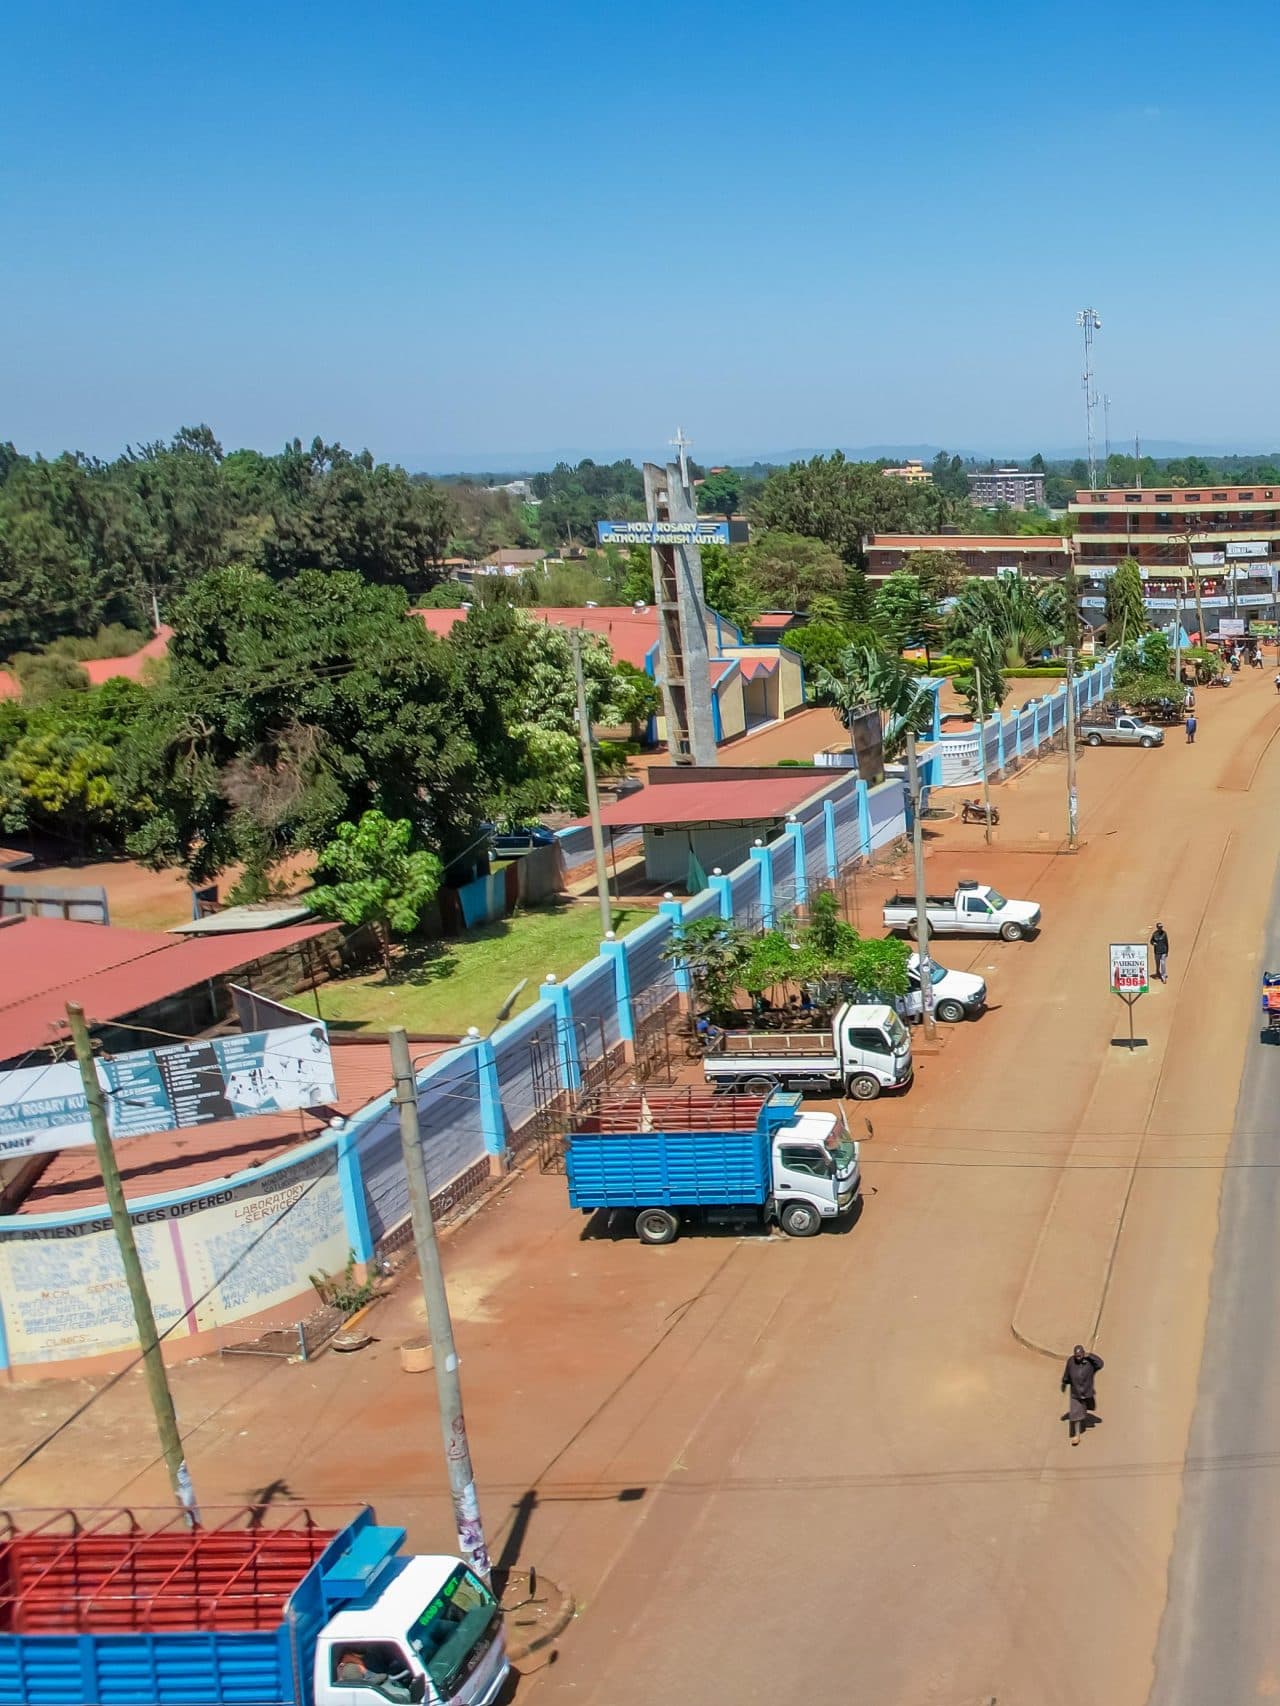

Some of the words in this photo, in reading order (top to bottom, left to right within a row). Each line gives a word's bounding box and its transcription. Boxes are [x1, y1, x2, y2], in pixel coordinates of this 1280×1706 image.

[602, 534, 651, 544] CATHOLIC
[653, 534, 690, 544] PARISH
[693, 534, 726, 544] KUTUS
[628, 522, 653, 533] HOLY
[656, 522, 698, 533] ROSARY
[234, 1183, 305, 1218] LABORATORY
[245, 1195, 300, 1224] SERVICES
[23, 1223, 87, 1241] PATIENT
[170, 1190, 233, 1218] OFFERED
